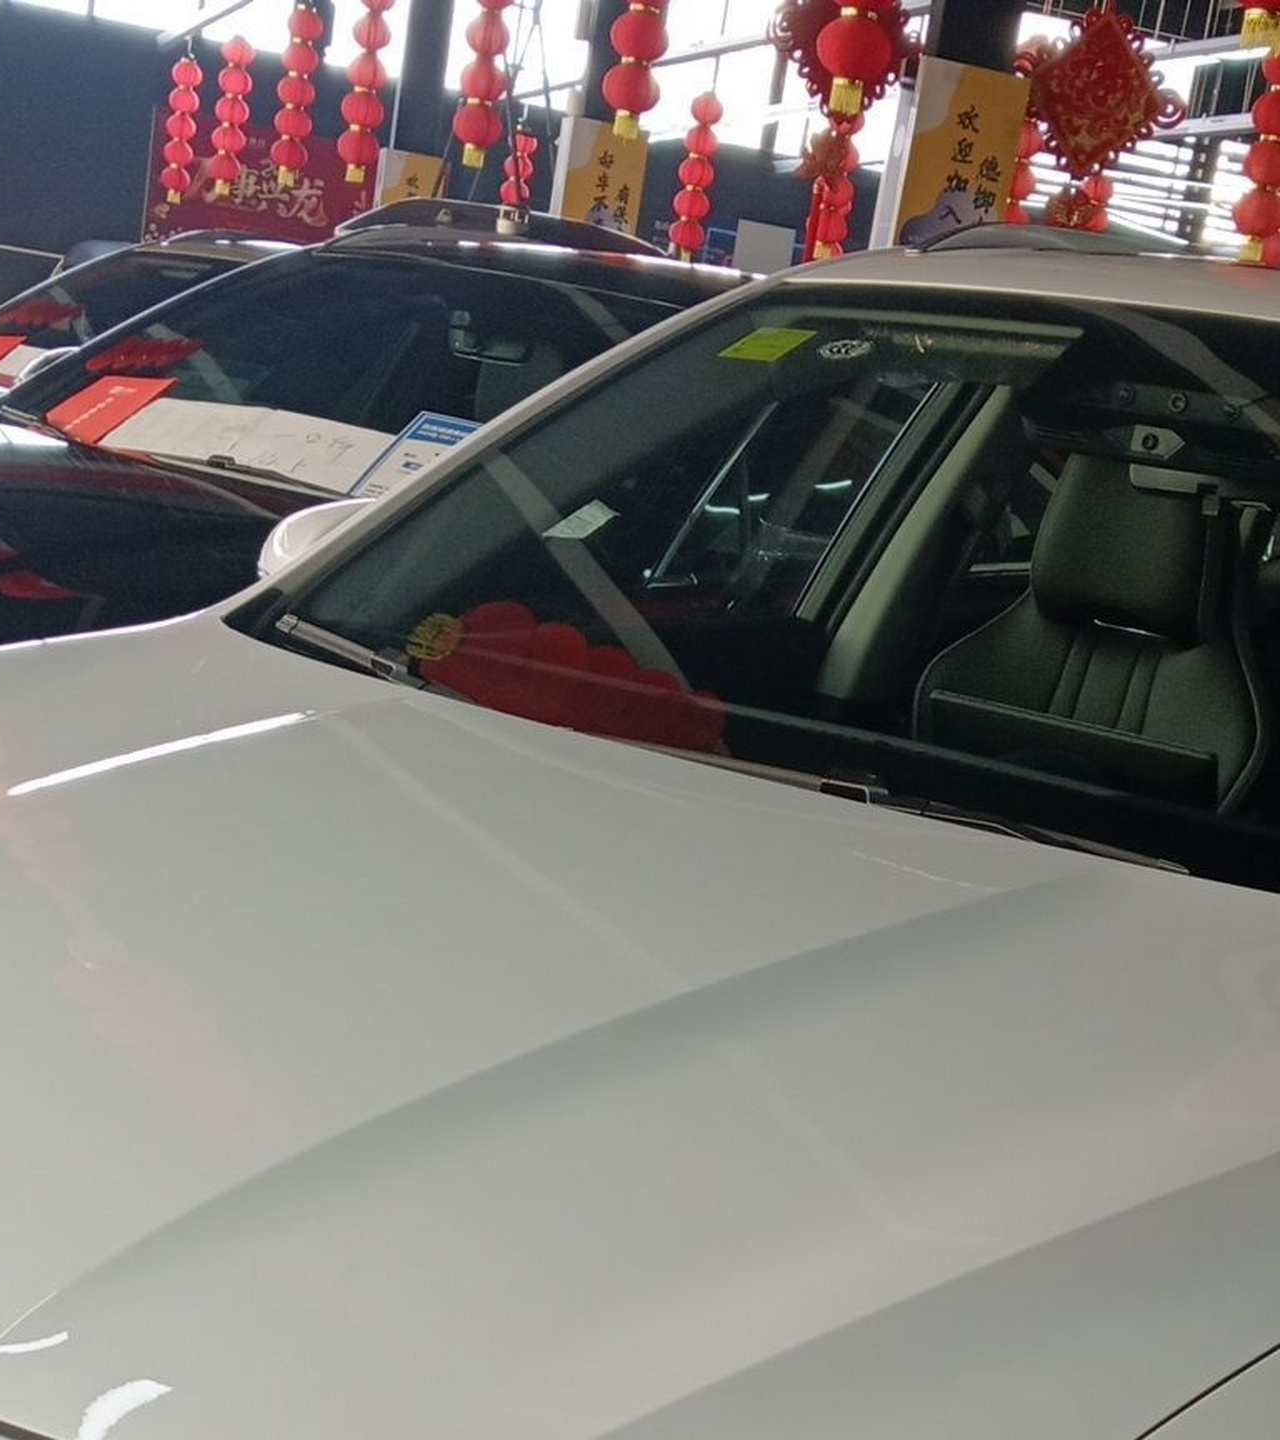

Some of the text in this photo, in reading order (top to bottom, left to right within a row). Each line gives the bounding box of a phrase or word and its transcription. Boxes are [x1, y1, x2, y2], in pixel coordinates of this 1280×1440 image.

[939, 106, 982, 225] 欢迎加入
[973, 155, 1002, 226] 德御
